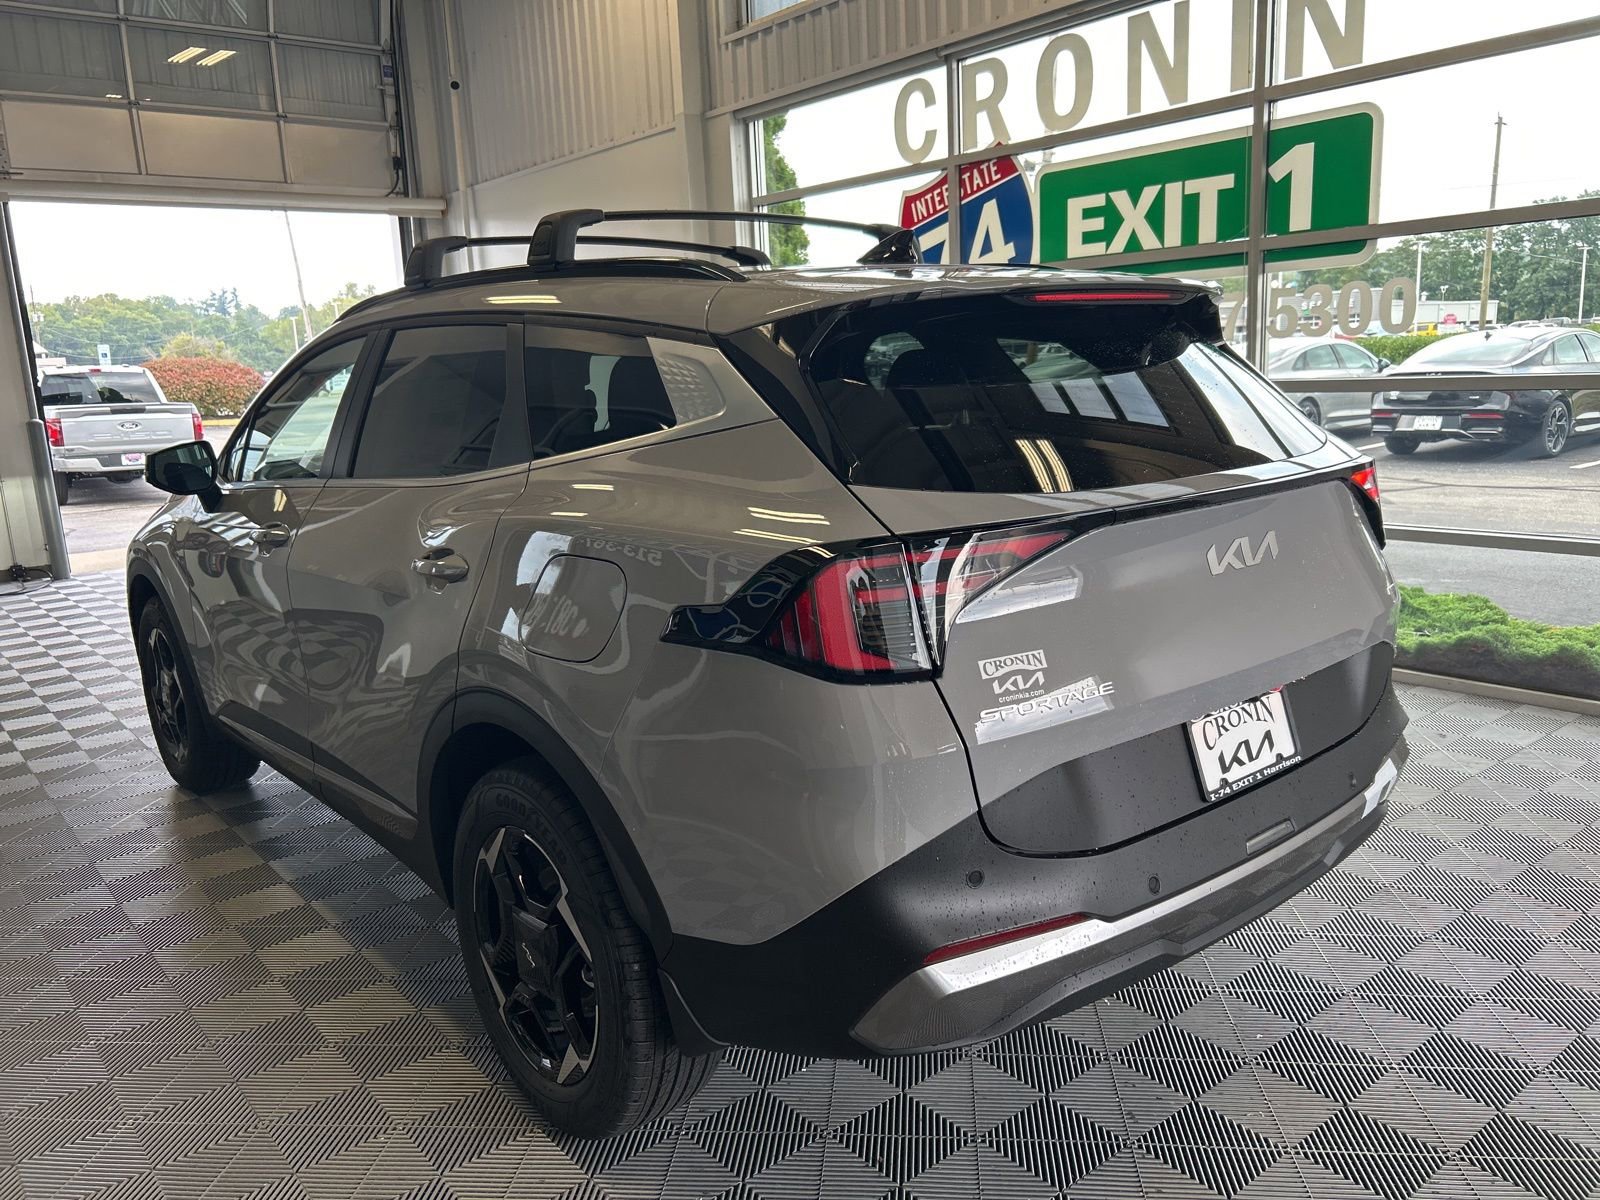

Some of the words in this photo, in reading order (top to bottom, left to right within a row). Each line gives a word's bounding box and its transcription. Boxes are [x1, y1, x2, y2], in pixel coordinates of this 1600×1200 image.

[894, 0, 1365, 164] CRONIN
[911, 159, 1001, 223] INTETATE
[1066, 174, 1234, 258] EXIT
[1268, 143, 1315, 232] 1
[918, 199, 1016, 264] 74
[983, 651, 1045, 676] CRONIN
[979, 682, 1115, 723] SPORTAGE
[998, 689, 1045, 703] croninkia.com
[1203, 697, 1275, 750] CRONIN
[1210, 786, 1231, 801] I-74
[1232, 776, 1255, 791] EXIT
[1263, 755, 1302, 775] Harrison
